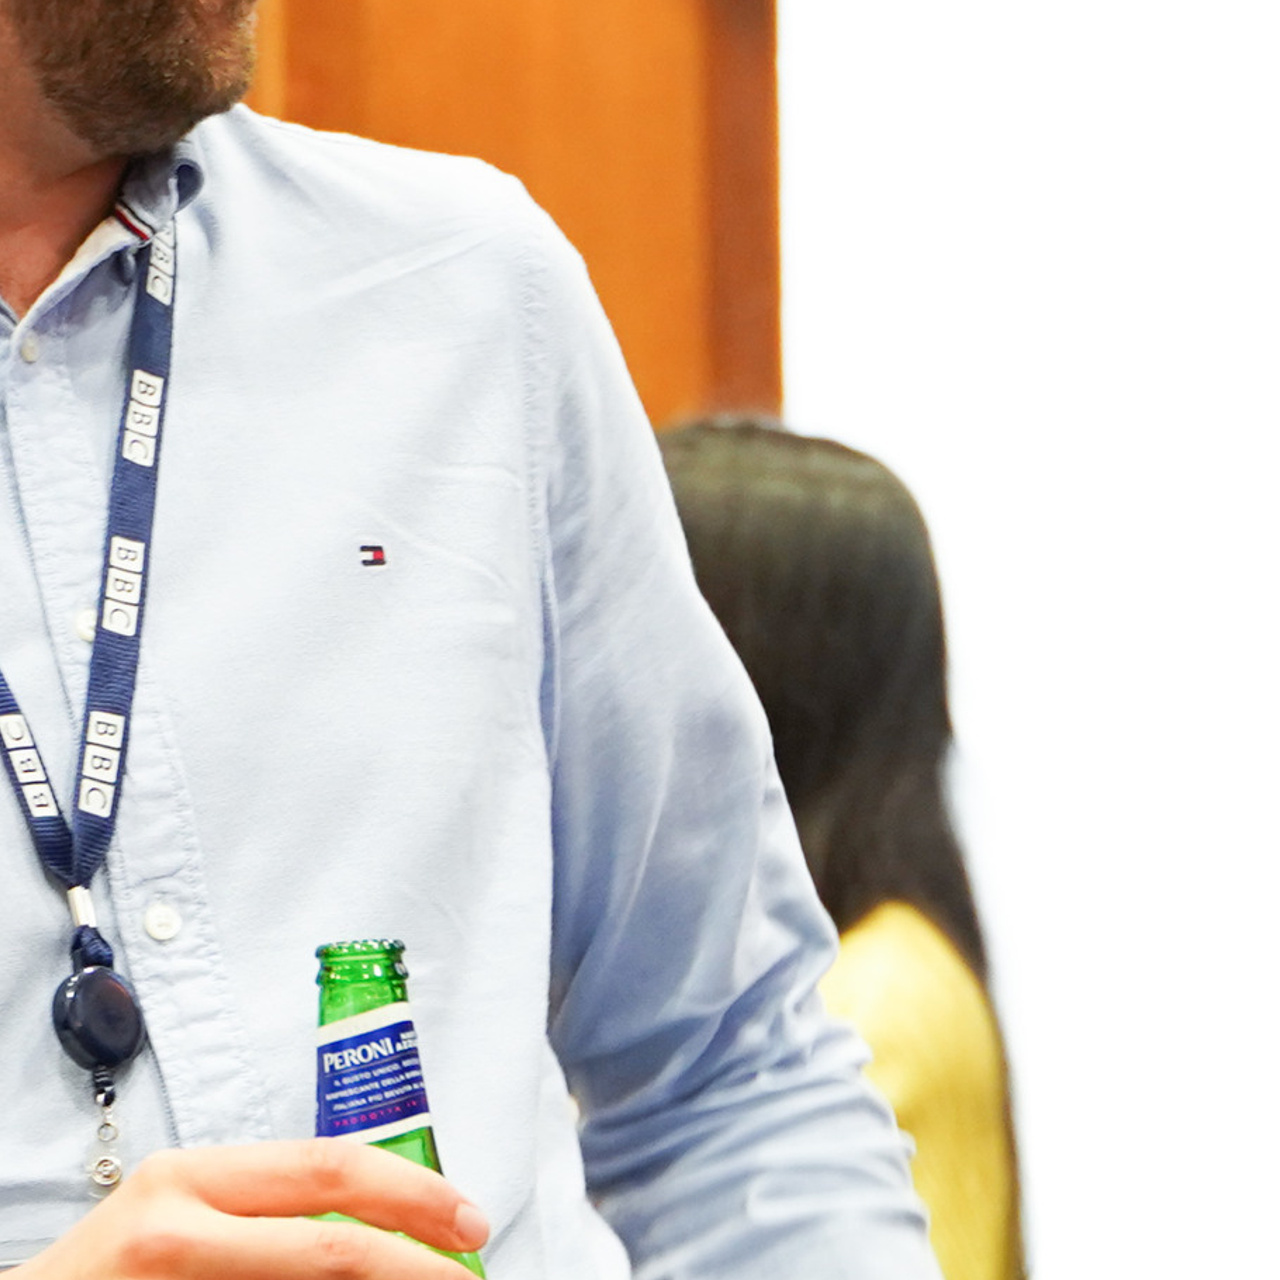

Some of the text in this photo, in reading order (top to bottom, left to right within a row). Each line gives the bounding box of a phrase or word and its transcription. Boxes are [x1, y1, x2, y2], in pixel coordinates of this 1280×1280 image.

[123, 370, 163, 465] BBC
[103, 537, 144, 635] BBC
[79, 712, 124, 817] BBC
[323, 1037, 395, 1073] PERONI
